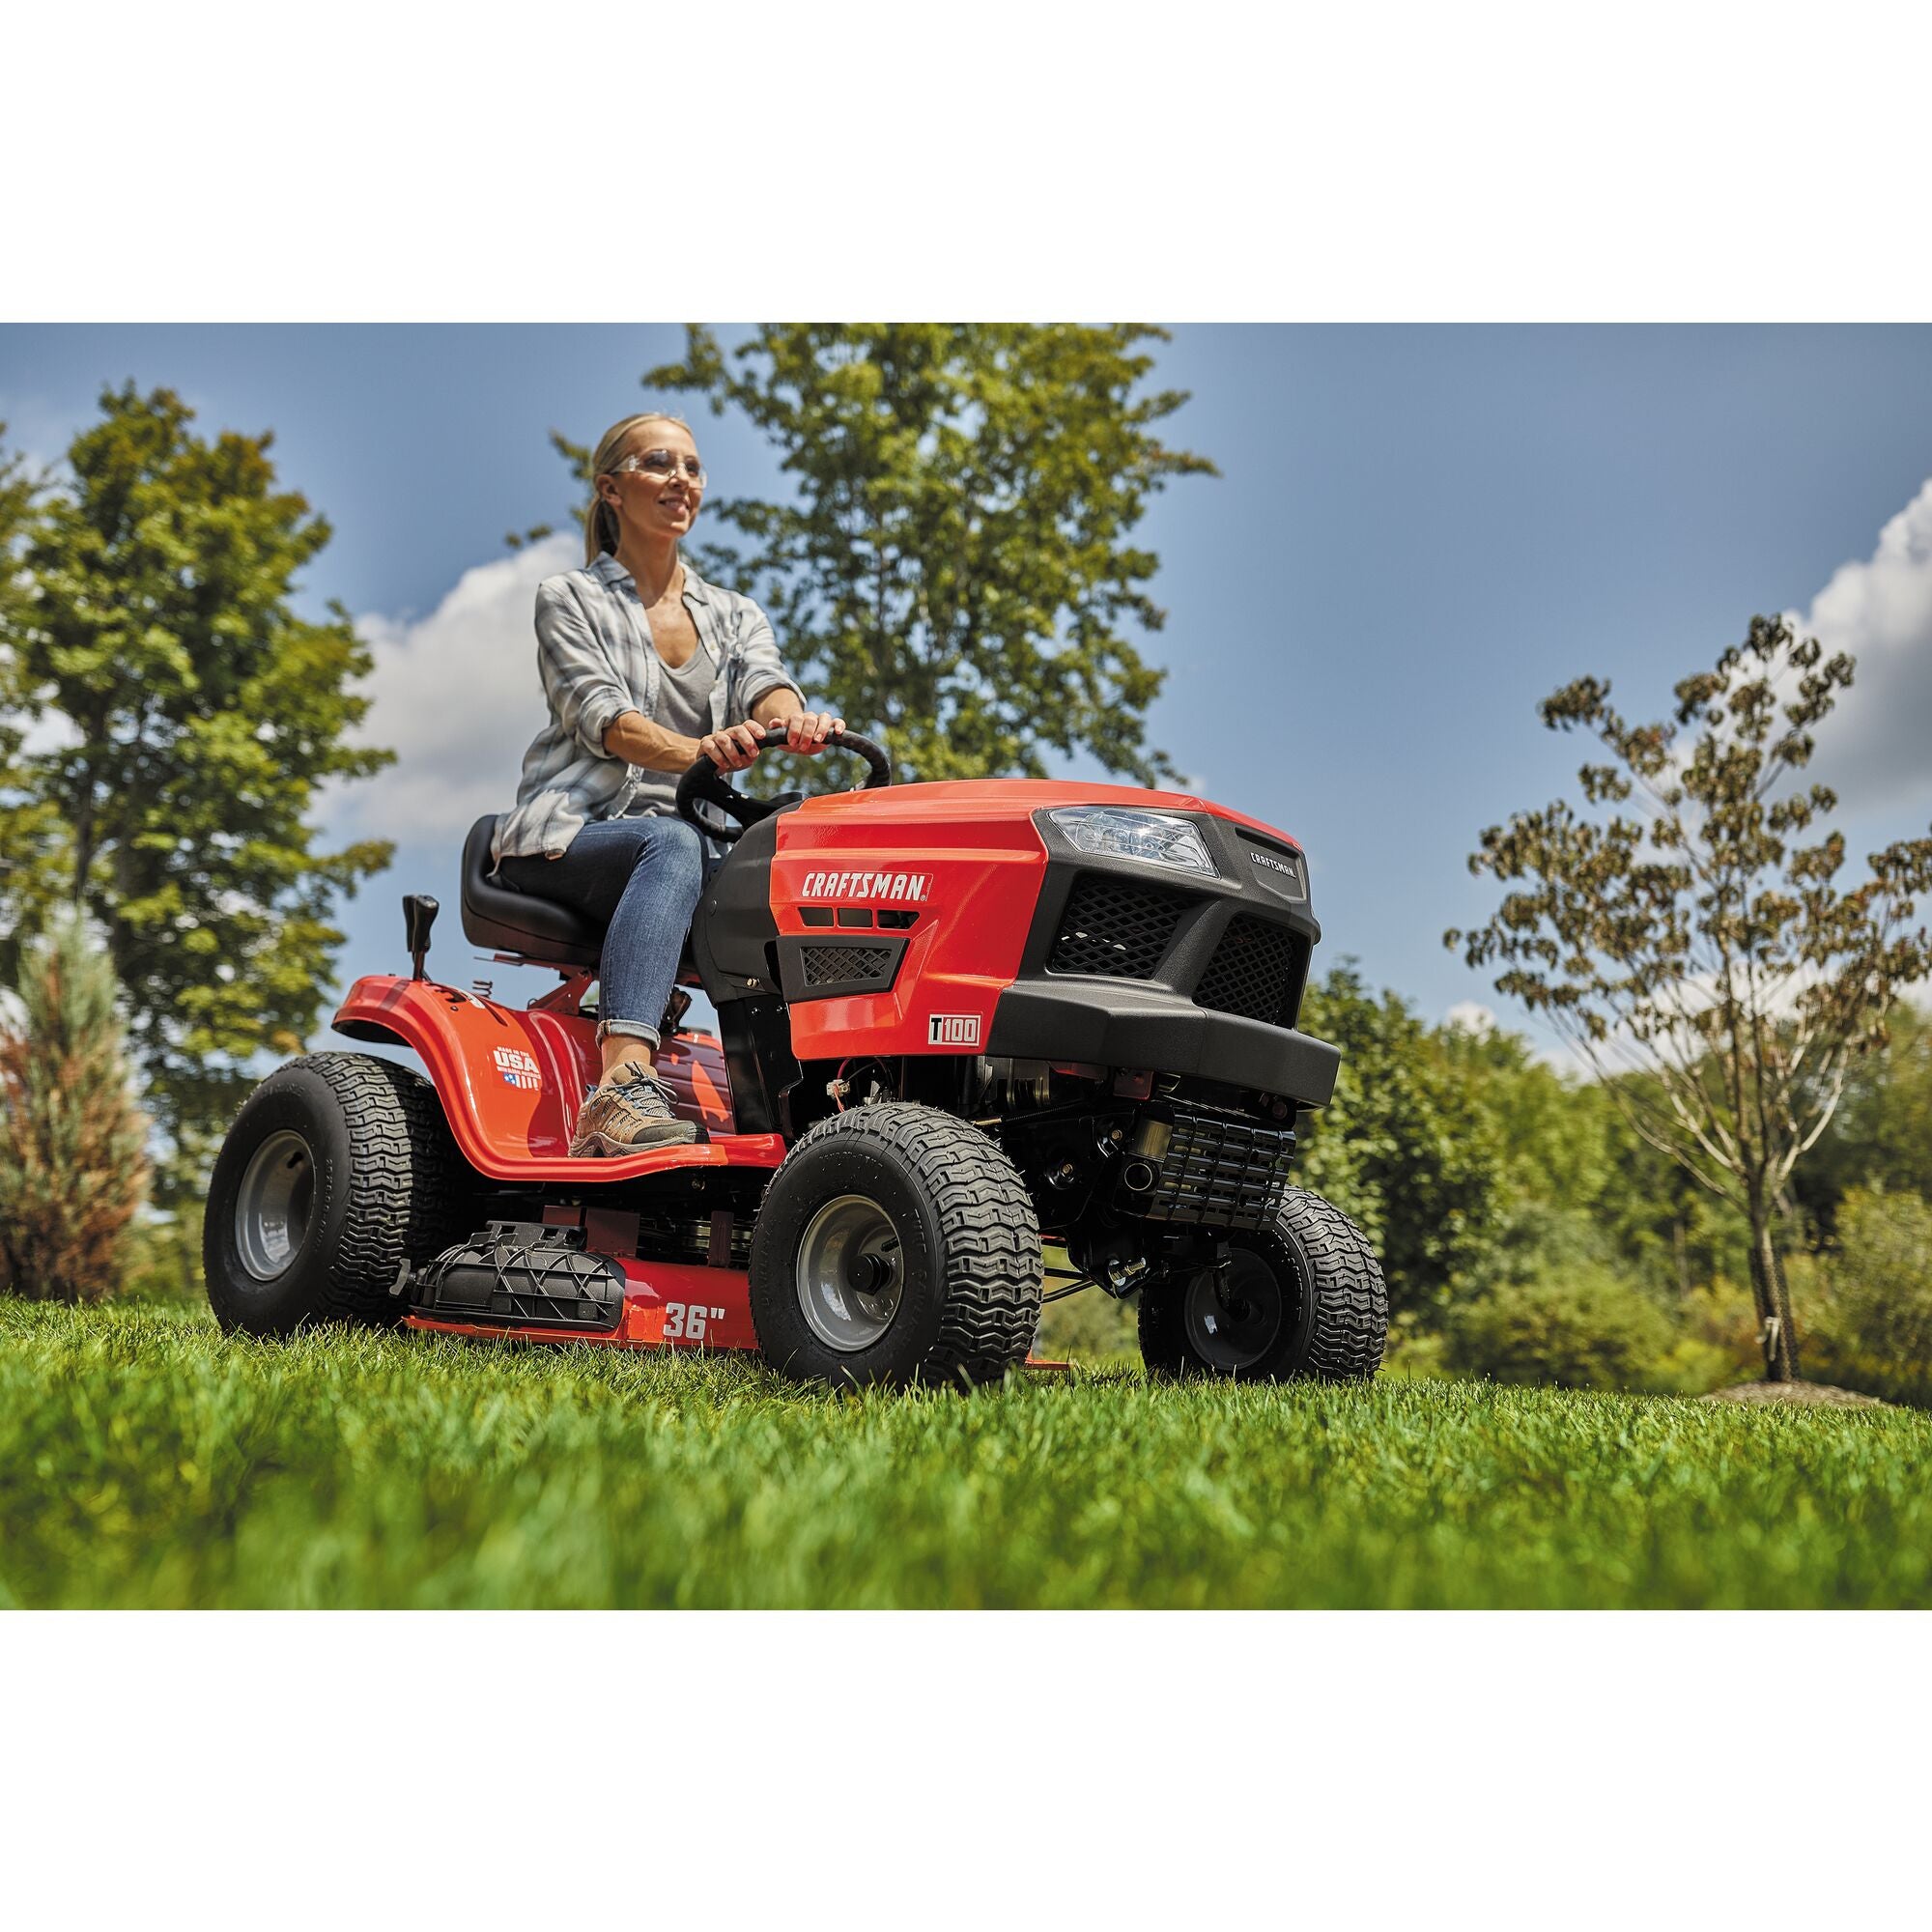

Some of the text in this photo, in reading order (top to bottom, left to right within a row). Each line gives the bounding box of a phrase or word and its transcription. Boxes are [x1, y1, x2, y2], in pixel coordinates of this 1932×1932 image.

[1250, 852, 1295, 877] CRAFTSMAN
[930, 1017, 977, 1042] T100
[493, 1050, 540, 1074] USA
[663, 1302, 725, 1340] 36"
